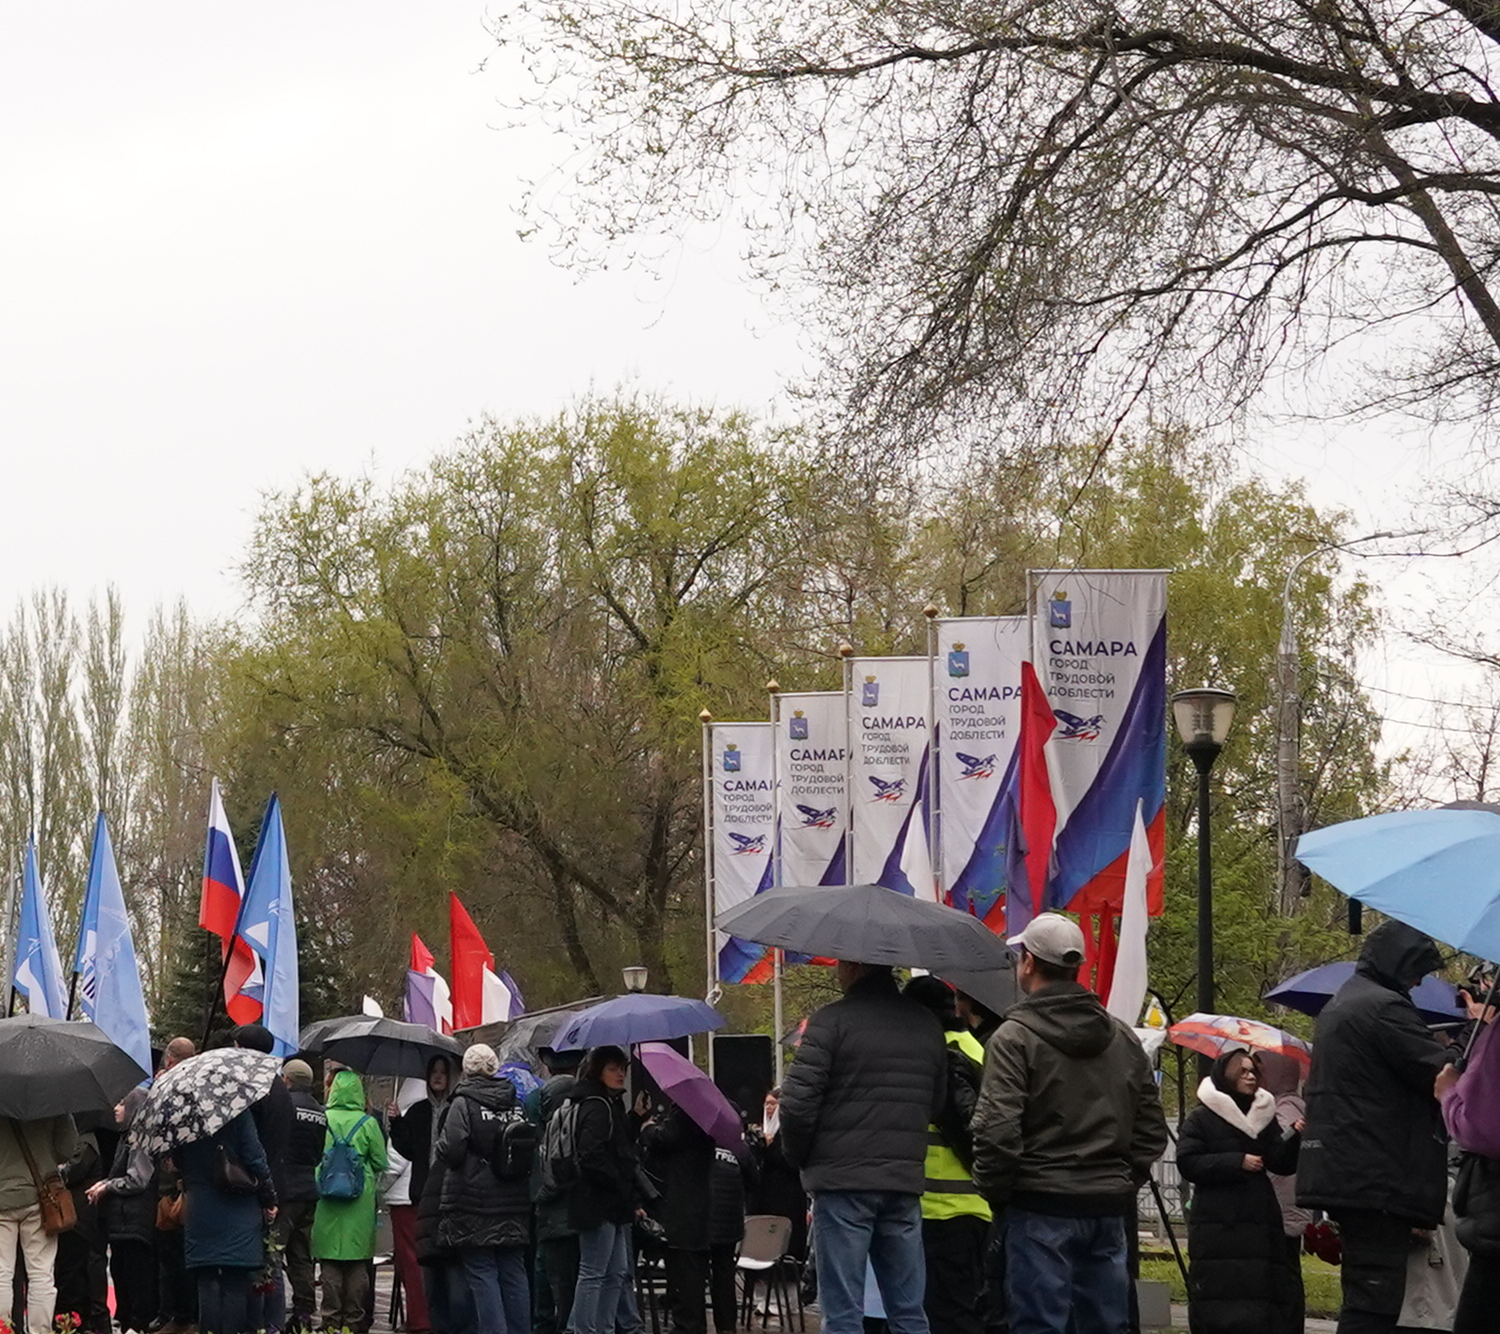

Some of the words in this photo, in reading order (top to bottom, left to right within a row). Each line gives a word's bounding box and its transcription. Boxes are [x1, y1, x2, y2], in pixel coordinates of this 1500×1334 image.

[1049, 639, 1138, 657] САМАРА
[1049, 657, 1089, 671] ГОРОД
[1050, 671, 1116, 685] ТРУДОВОЙ
[1048, 686, 1115, 699] ДОБЛЕСТИ
[949, 704, 985, 715] ГОРОД
[862, 716, 926, 729] САМАРА
[950, 715, 1006, 728] ТРУДОВОЙ
[862, 732, 891, 742] ГОРОД
[949, 730, 1005, 740] ДОБЛЕСТИ
[861, 743, 910, 754] ТРУДОВОЙ
[863, 755, 910, 765] ДОБЛЕСТИ
[790, 763, 825, 773] ГОРОД
[791, 773, 845, 784] ТРУДОВОЙ
[791, 785, 845, 795] ДОБЛЕСТИ
[723, 793, 755, 803] ГОРОД
[723, 803, 773, 813] ТРУДОВОЙ
[723, 814, 773, 824] ДОБЛЕСТИ
